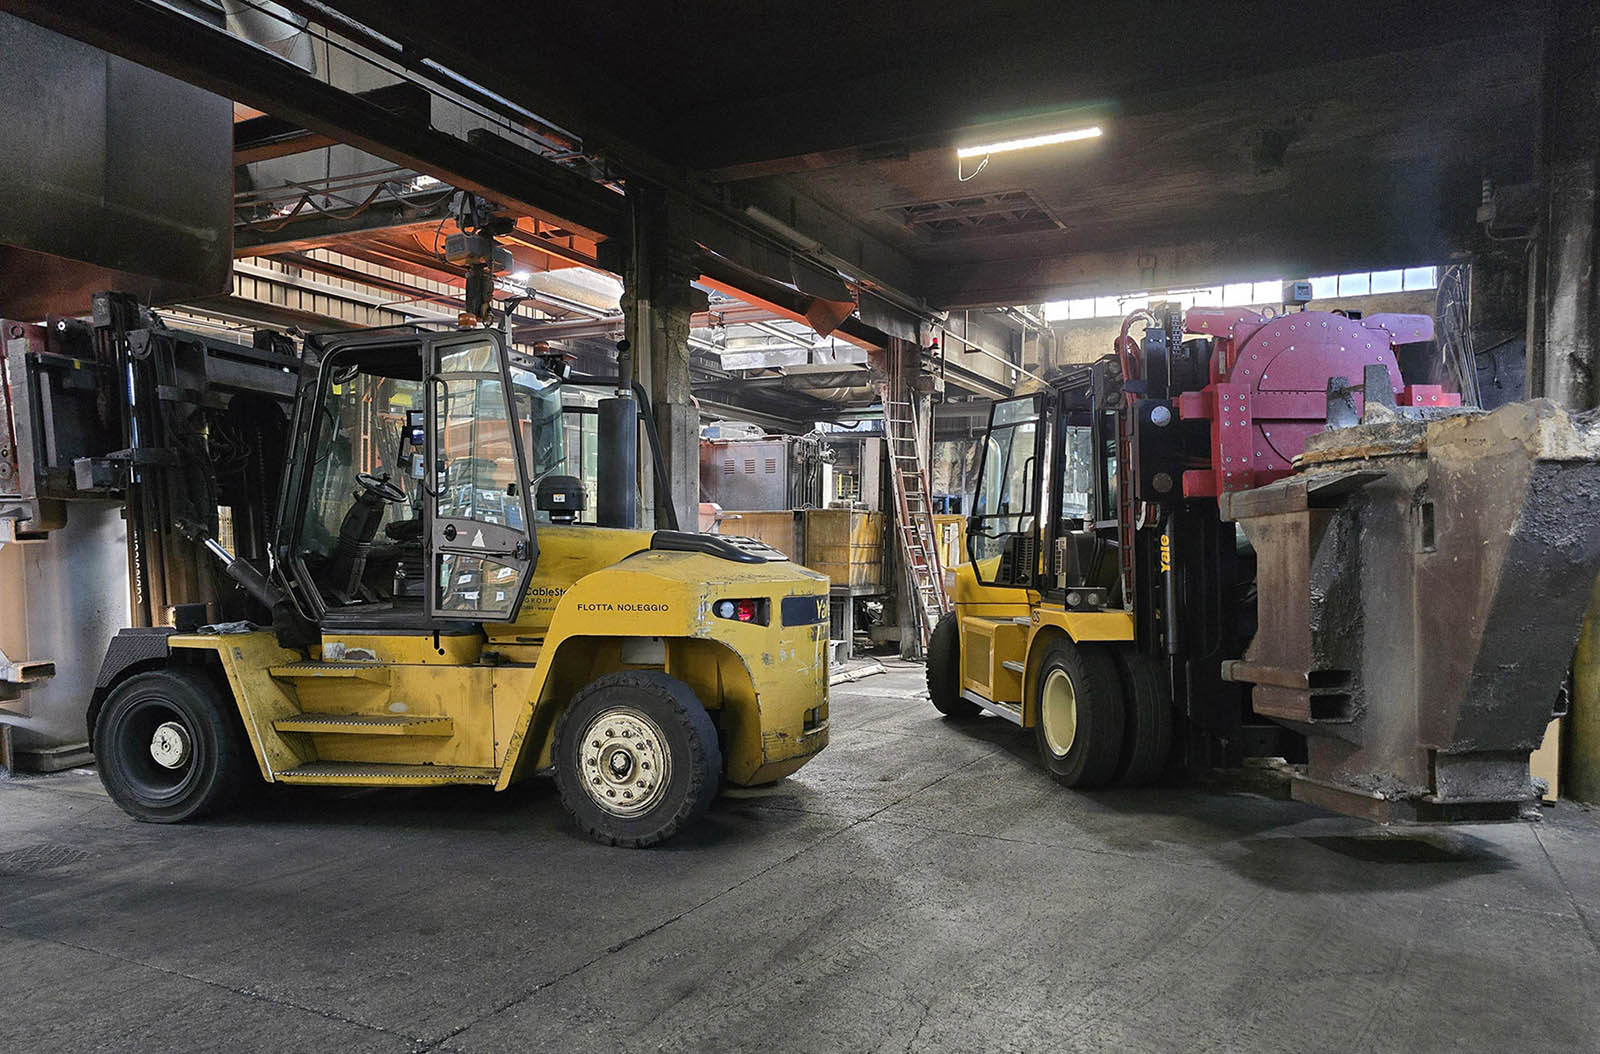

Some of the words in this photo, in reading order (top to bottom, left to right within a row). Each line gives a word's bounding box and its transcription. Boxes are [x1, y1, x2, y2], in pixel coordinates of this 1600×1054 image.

[1160, 534, 1171, 574] Yale
[577, 603, 613, 611] FLOTTA
[617, 603, 669, 612] NOLEGGIO
